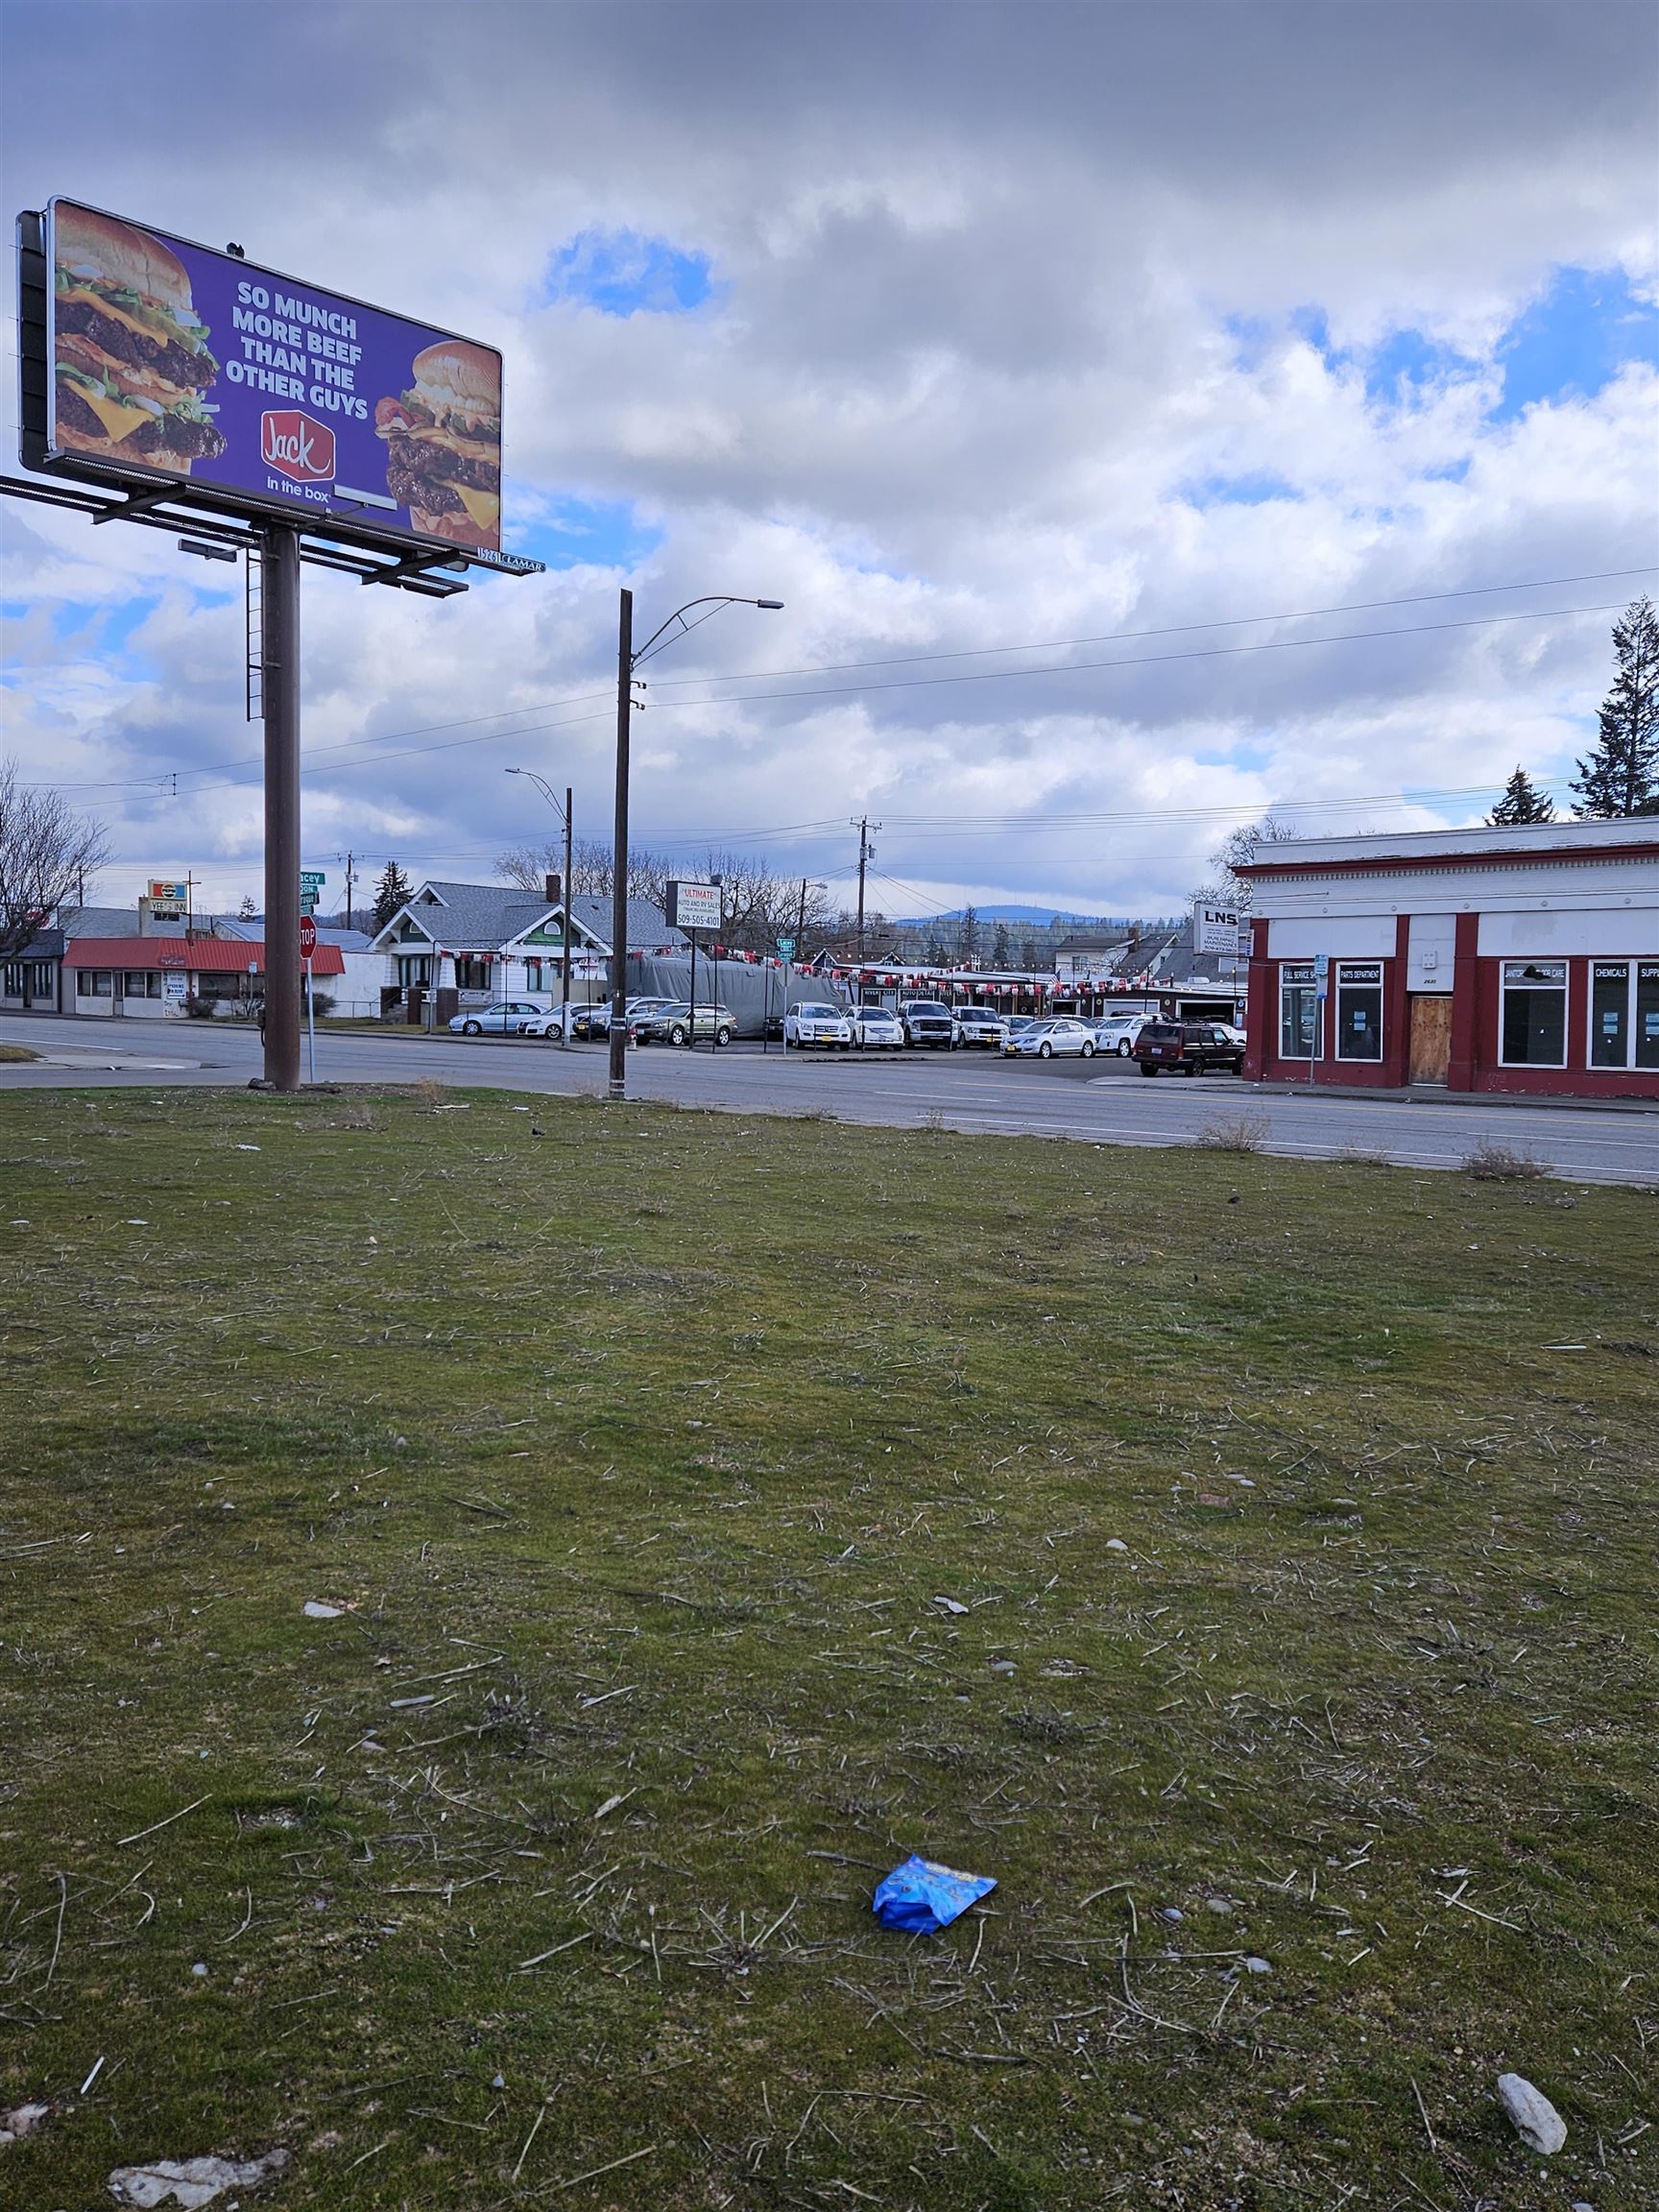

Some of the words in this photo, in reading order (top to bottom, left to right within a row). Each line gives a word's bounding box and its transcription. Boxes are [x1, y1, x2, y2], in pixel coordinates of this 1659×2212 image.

[237, 281, 270, 309] SO
[275, 293, 357, 340] MUNCH
[232, 306, 302, 349] MORE
[307, 330, 362, 366] BEEF
[240, 336, 307, 376] THAN
[311, 358, 354, 391] THE
[226, 360, 305, 401] OTHER
[309, 385, 368, 420] GUYS
[264, 417, 331, 474] Jack
[267, 476, 278, 491] in
[281, 481, 301, 496] the
[304, 486, 329, 503] box
[300, 873, 320, 883] acey
[678, 913, 720, 926] 509-505-4101
[1205, 910, 1238, 926] LNS
[300, 929, 315, 946] TOP
[1340, 971, 1354, 979] PARTS
[1354, 970, 1380, 979] DEPARTMENT
[1595, 968, 1627, 978] CHEMICALS
